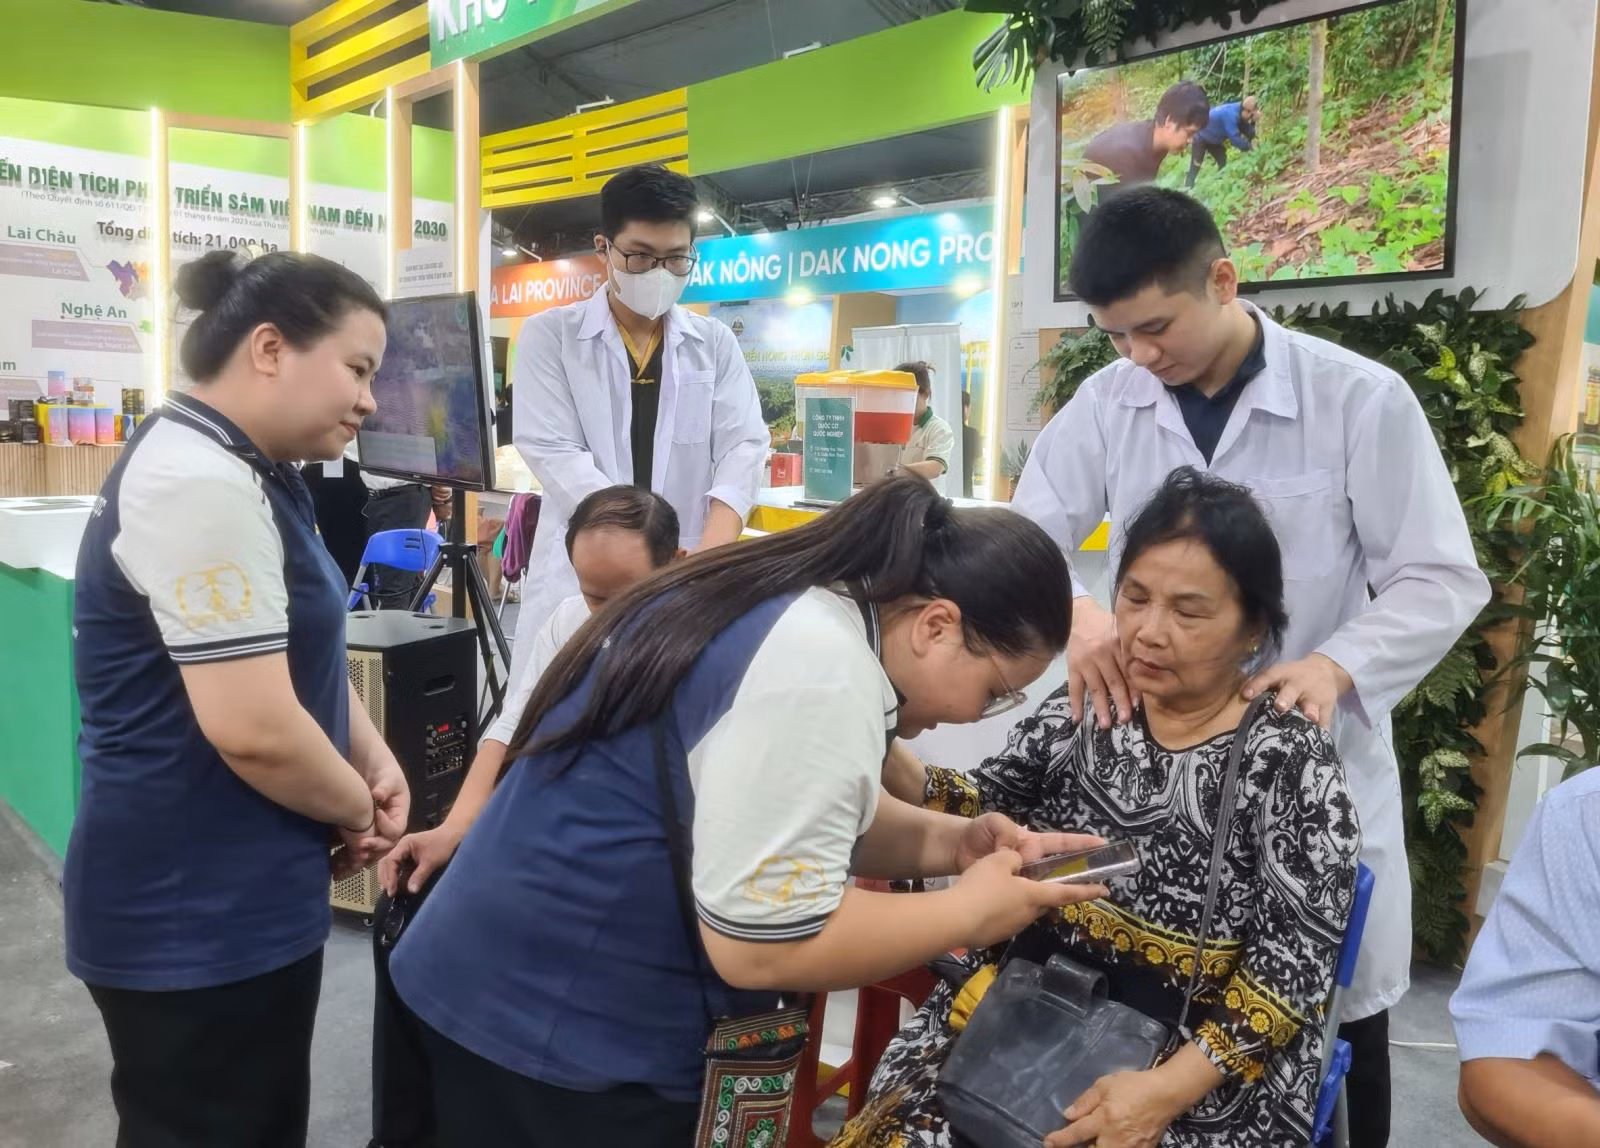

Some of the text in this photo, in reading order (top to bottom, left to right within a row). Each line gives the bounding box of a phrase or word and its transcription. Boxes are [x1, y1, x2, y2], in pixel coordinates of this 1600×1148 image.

[0, 157, 21, 182] ẾN
[29, 166, 72, 190] DIỆN
[79, 171, 119, 195] TÍCH
[125, 179, 148, 198] PH
[176, 184, 222, 209] TRIỂN
[228, 192, 264, 213] SÂM
[308, 205, 340, 223] NAM
[345, 207, 373, 228] ĐẾN
[415, 219, 446, 237] 2030
[7, 225, 77, 244] Lai Châu
[97, 220, 134, 241] Tổng
[173, 231, 202, 245] tích:
[688, 231, 994, 287] ẮK NÔNG DAK NONG PRO
[502, 281, 522, 304] LAI
[526, 272, 601, 303] PROVINCE
[61, 302, 127, 320] Nghệ An
